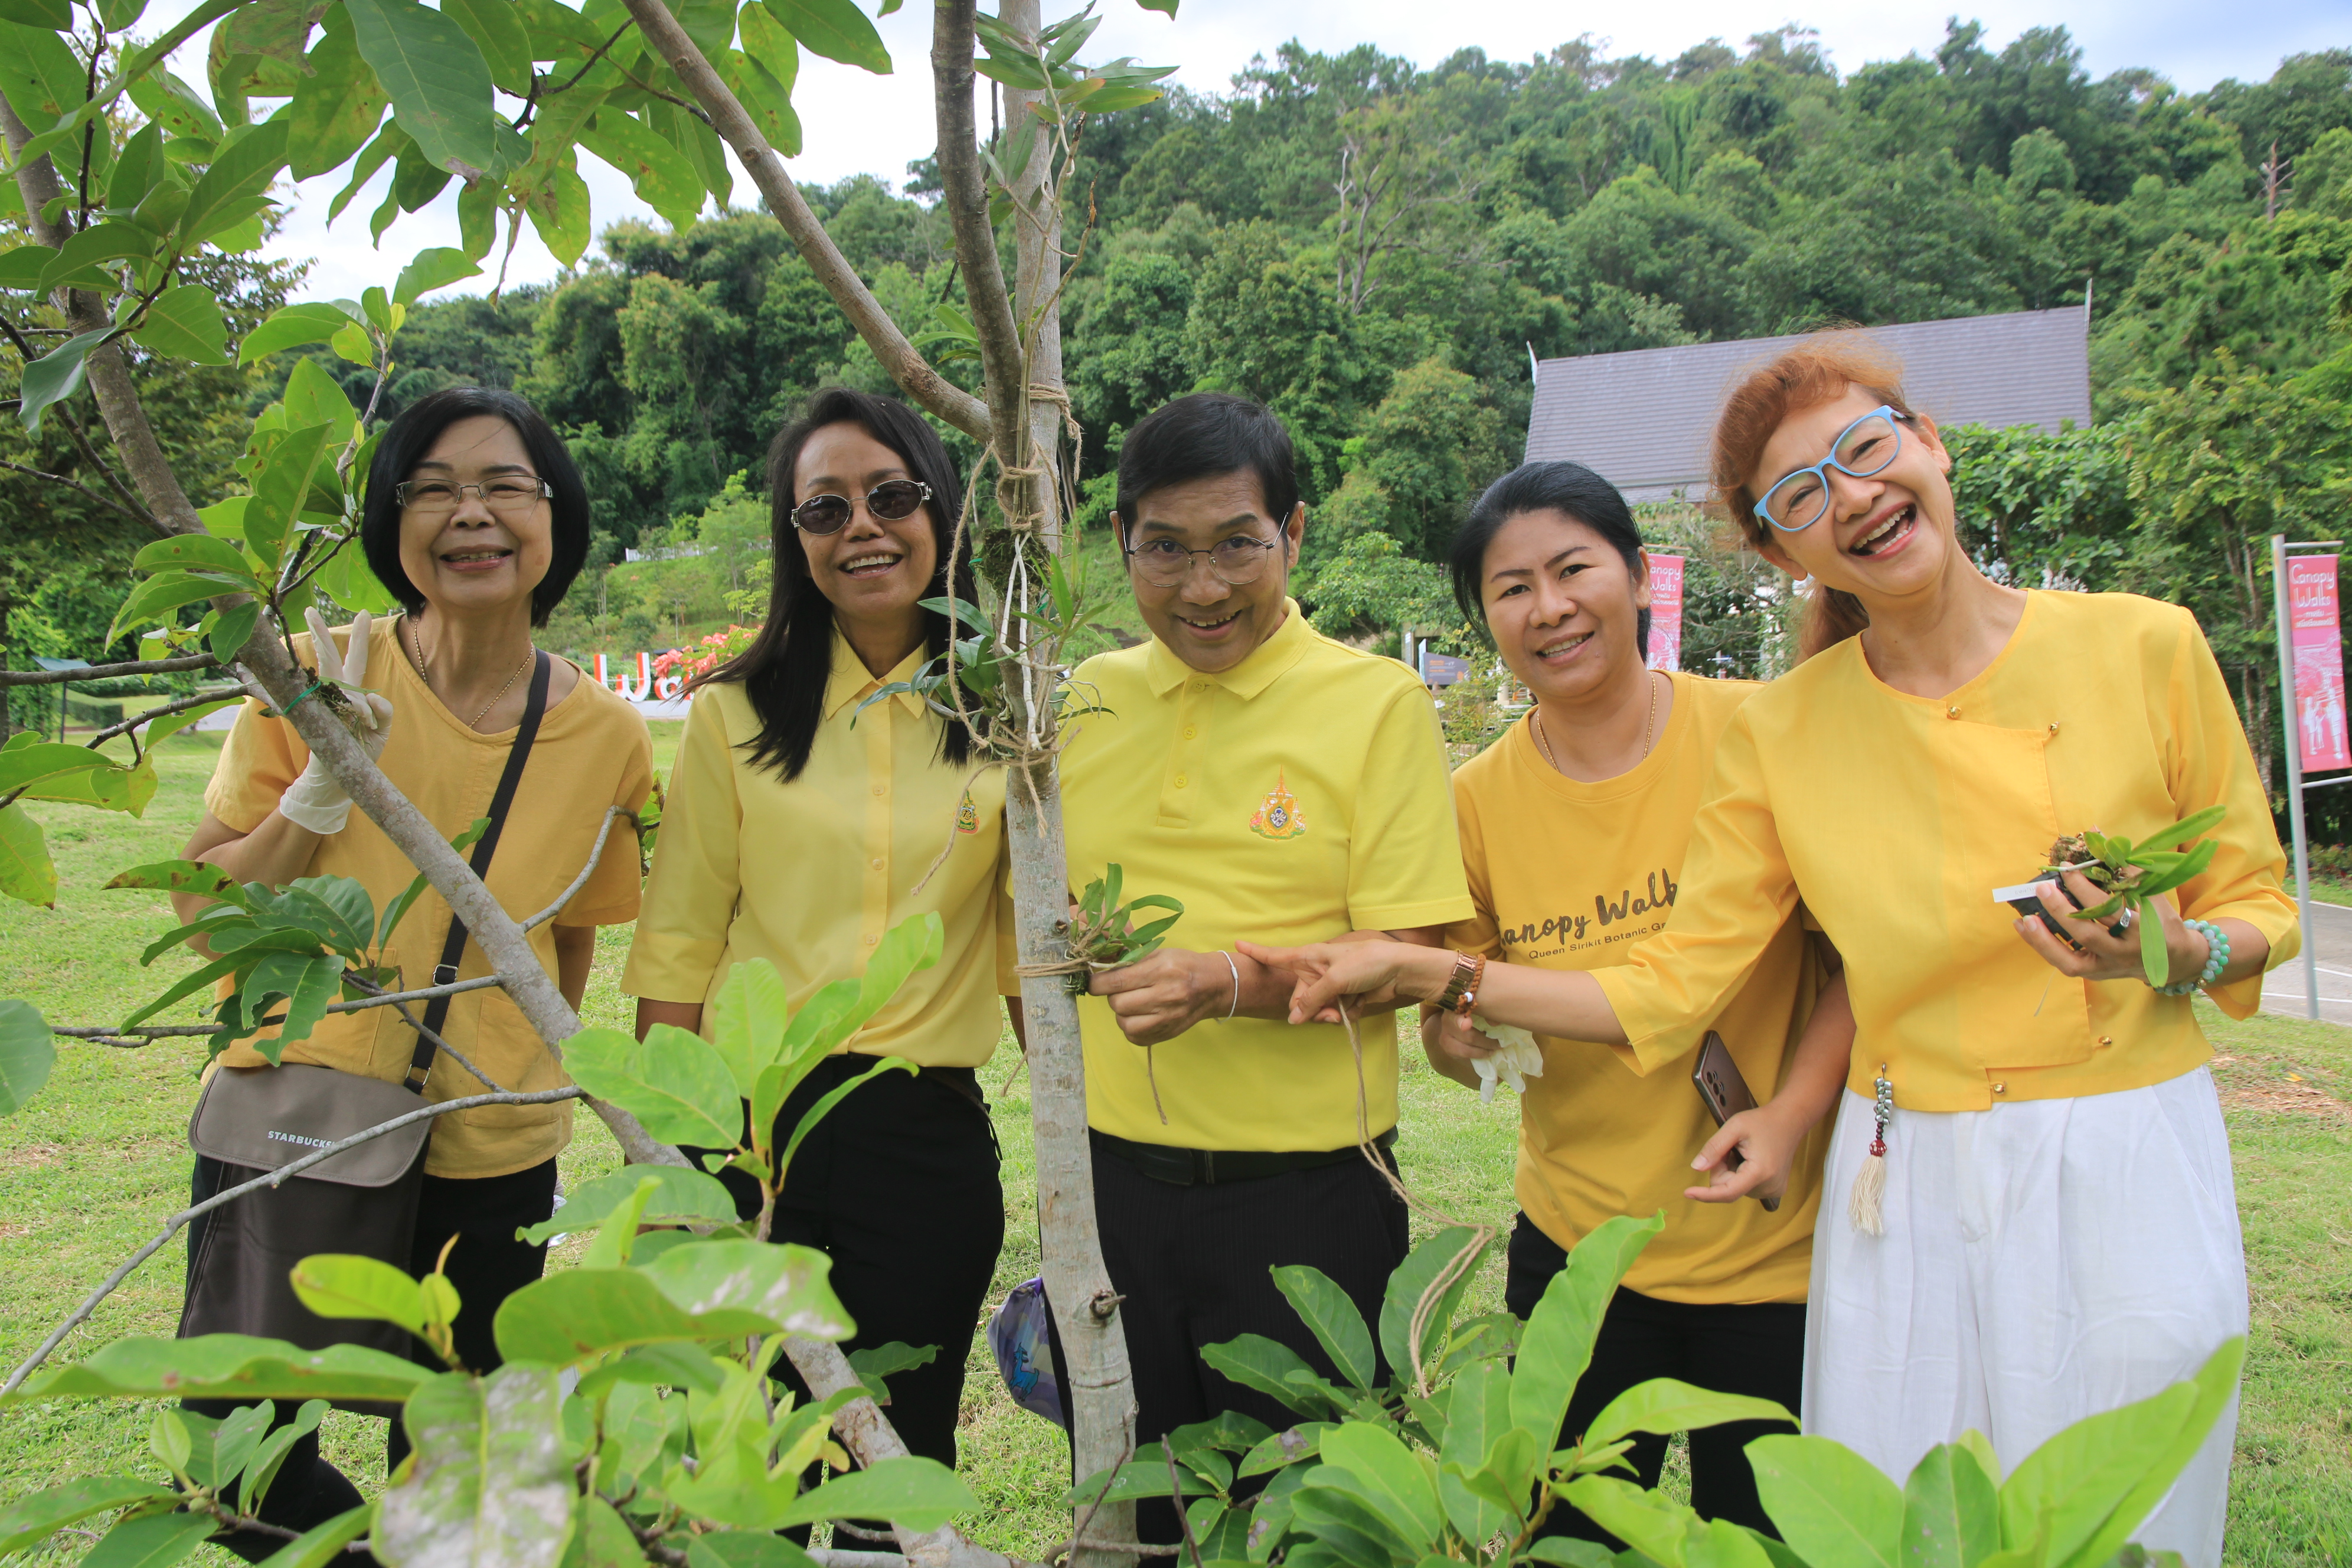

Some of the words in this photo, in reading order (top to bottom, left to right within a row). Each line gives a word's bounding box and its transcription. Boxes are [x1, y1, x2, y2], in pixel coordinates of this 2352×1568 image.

[2289, 564, 2335, 590] Canopy
[2294, 586, 2331, 608] Walks
[1497, 913, 1592, 946] anopy
[1528, 948, 1565, 959] Queen
[1569, 939, 1602, 951] Sirikit
[1604, 927, 1648, 943] Botanic
